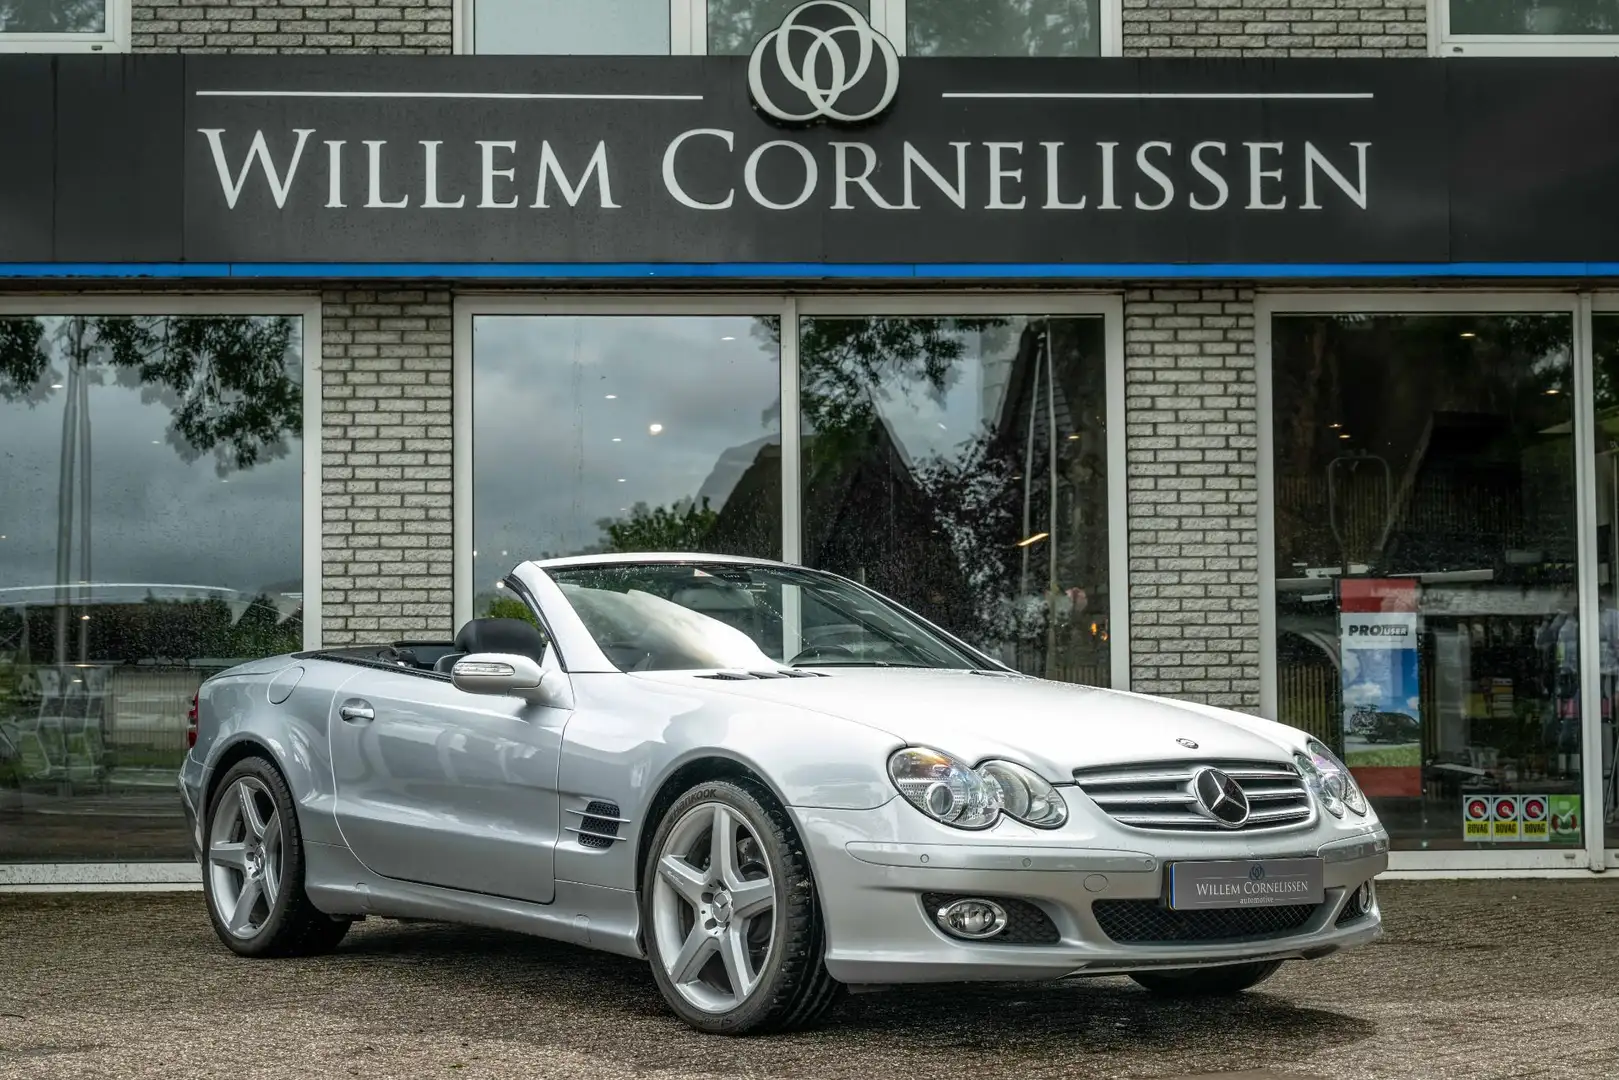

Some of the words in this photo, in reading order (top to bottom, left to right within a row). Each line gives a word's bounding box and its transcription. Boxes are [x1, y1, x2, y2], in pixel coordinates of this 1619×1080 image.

[1467, 823, 1489, 834] BOVAG
[1495, 823, 1517, 834] BOVAG
[1524, 823, 1546, 834] BOVAG
[1240, 896, 1274, 904] automotive
